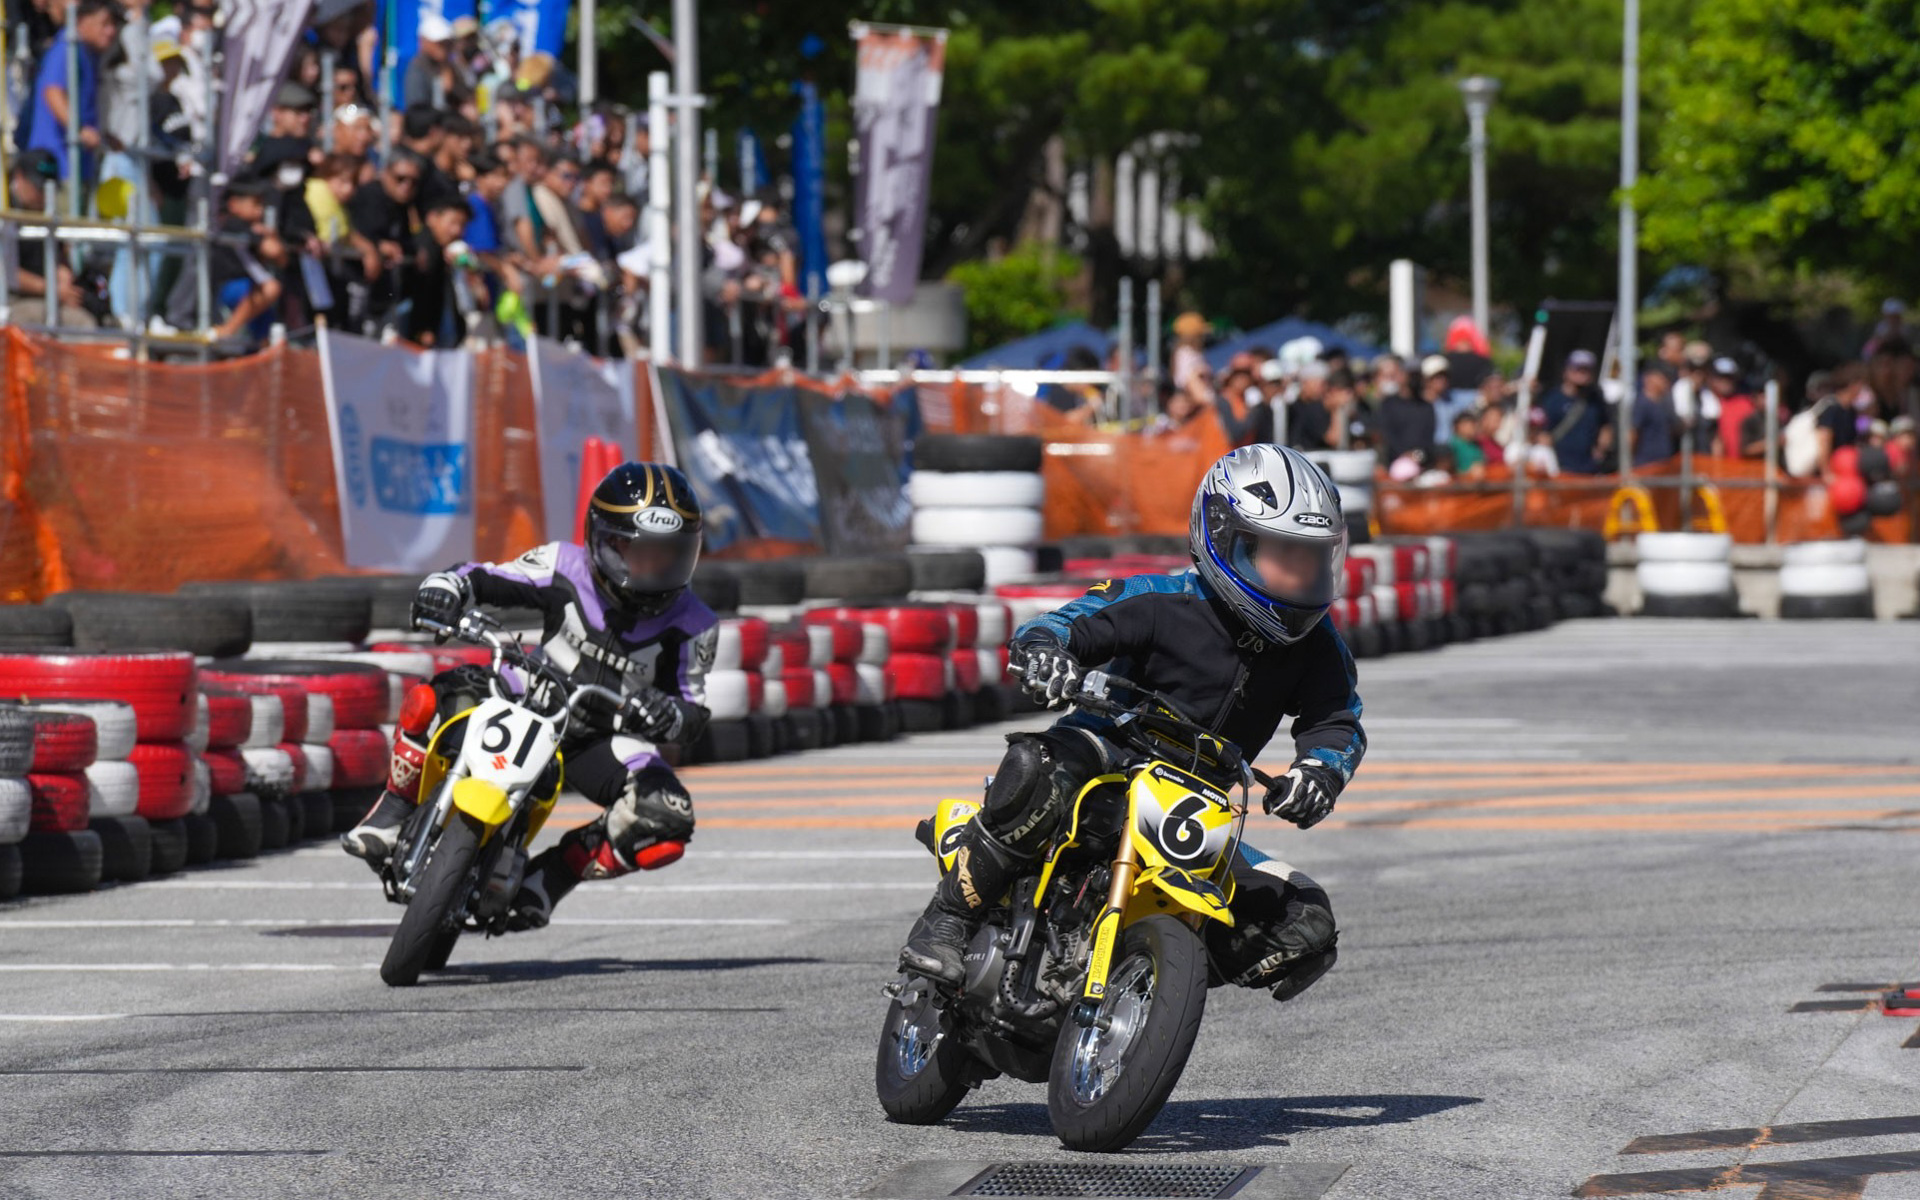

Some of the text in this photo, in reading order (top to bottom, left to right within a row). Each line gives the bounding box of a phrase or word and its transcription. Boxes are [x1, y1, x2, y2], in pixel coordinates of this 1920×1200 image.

[637, 508, 680, 529] Arai
[481, 708, 543, 769] 61
[1201, 788, 1227, 806] MOTUL
[1158, 792, 1210, 860] 6
